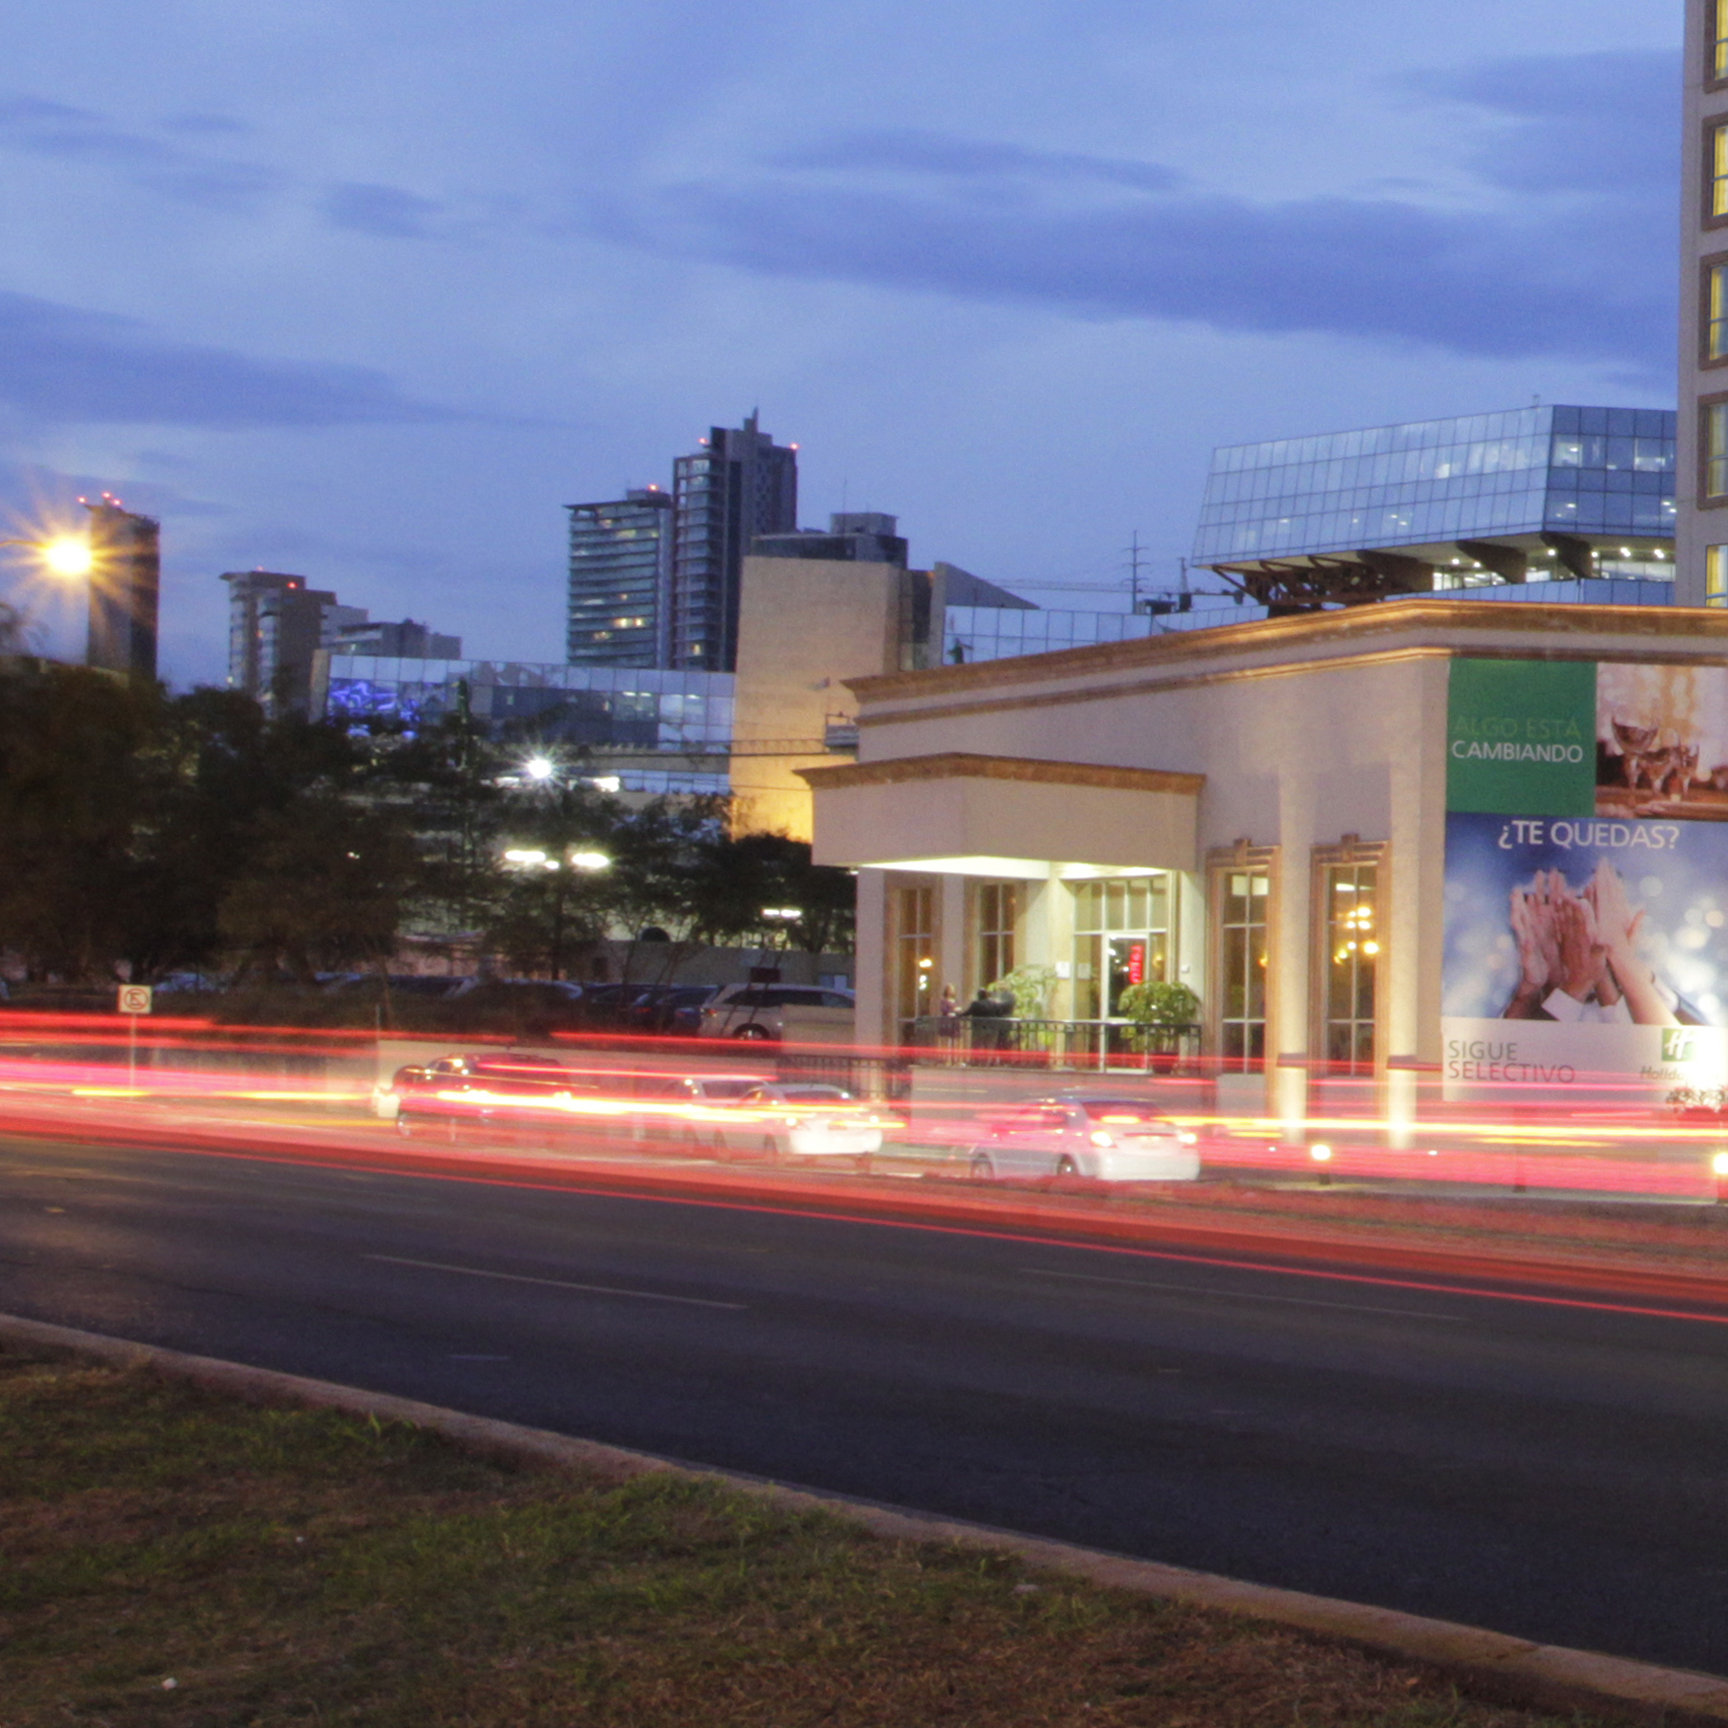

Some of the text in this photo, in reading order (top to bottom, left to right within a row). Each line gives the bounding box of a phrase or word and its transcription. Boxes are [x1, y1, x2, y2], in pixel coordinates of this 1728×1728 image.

[1453, 715, 1518, 738] ALGO
[1452, 740, 1583, 763] CAMBIANDO
[1498, 821, 1680, 850] ¿TE QUEDAS?
[1448, 1039, 1518, 1061] SIGUE
[1448, 1060, 1576, 1084] SELECTIVO
